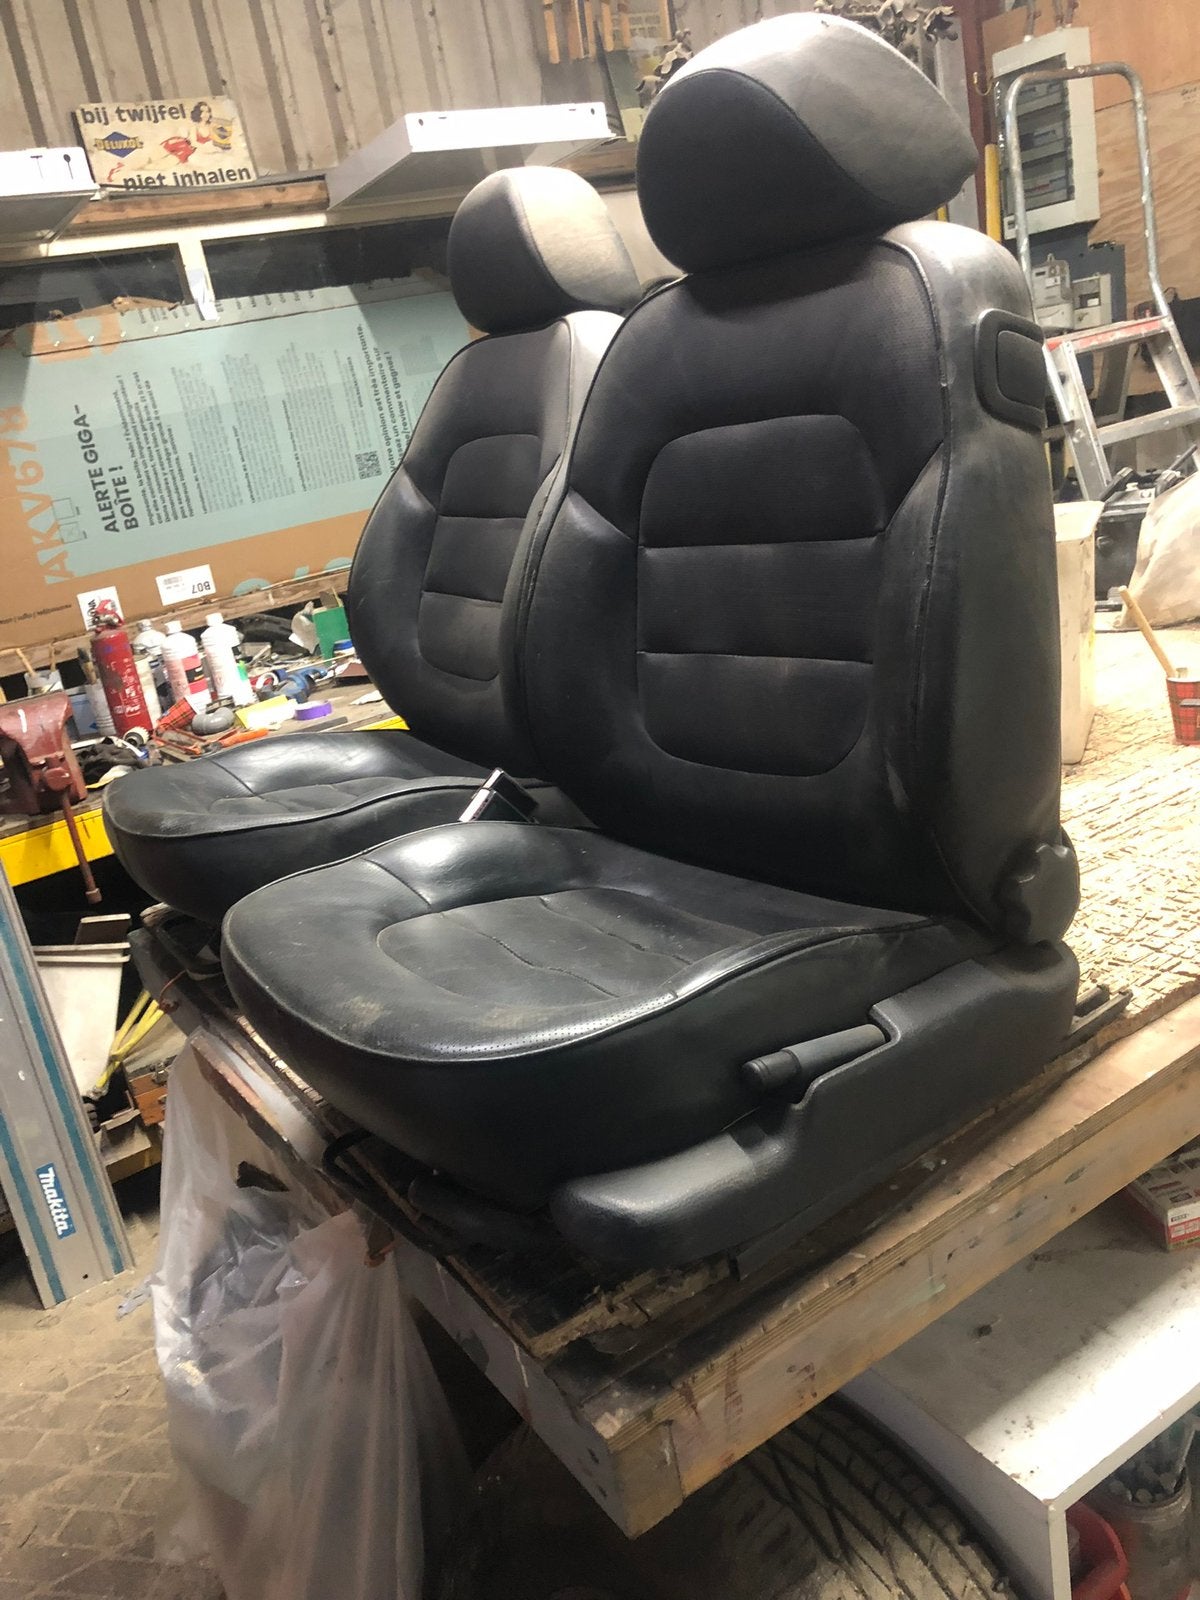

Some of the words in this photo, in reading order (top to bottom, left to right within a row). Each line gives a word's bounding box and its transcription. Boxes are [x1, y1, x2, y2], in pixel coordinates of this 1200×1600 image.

[80, 106, 109, 125] bij
[115, 103, 186, 123] twijfel
[123, 173, 167, 190] niet
[172, 167, 251, 187] inhalen
[88, 467, 120, 532] ALERTE
[111, 476, 139, 530] BOÎTE
[191, 580, 211, 594] B07
